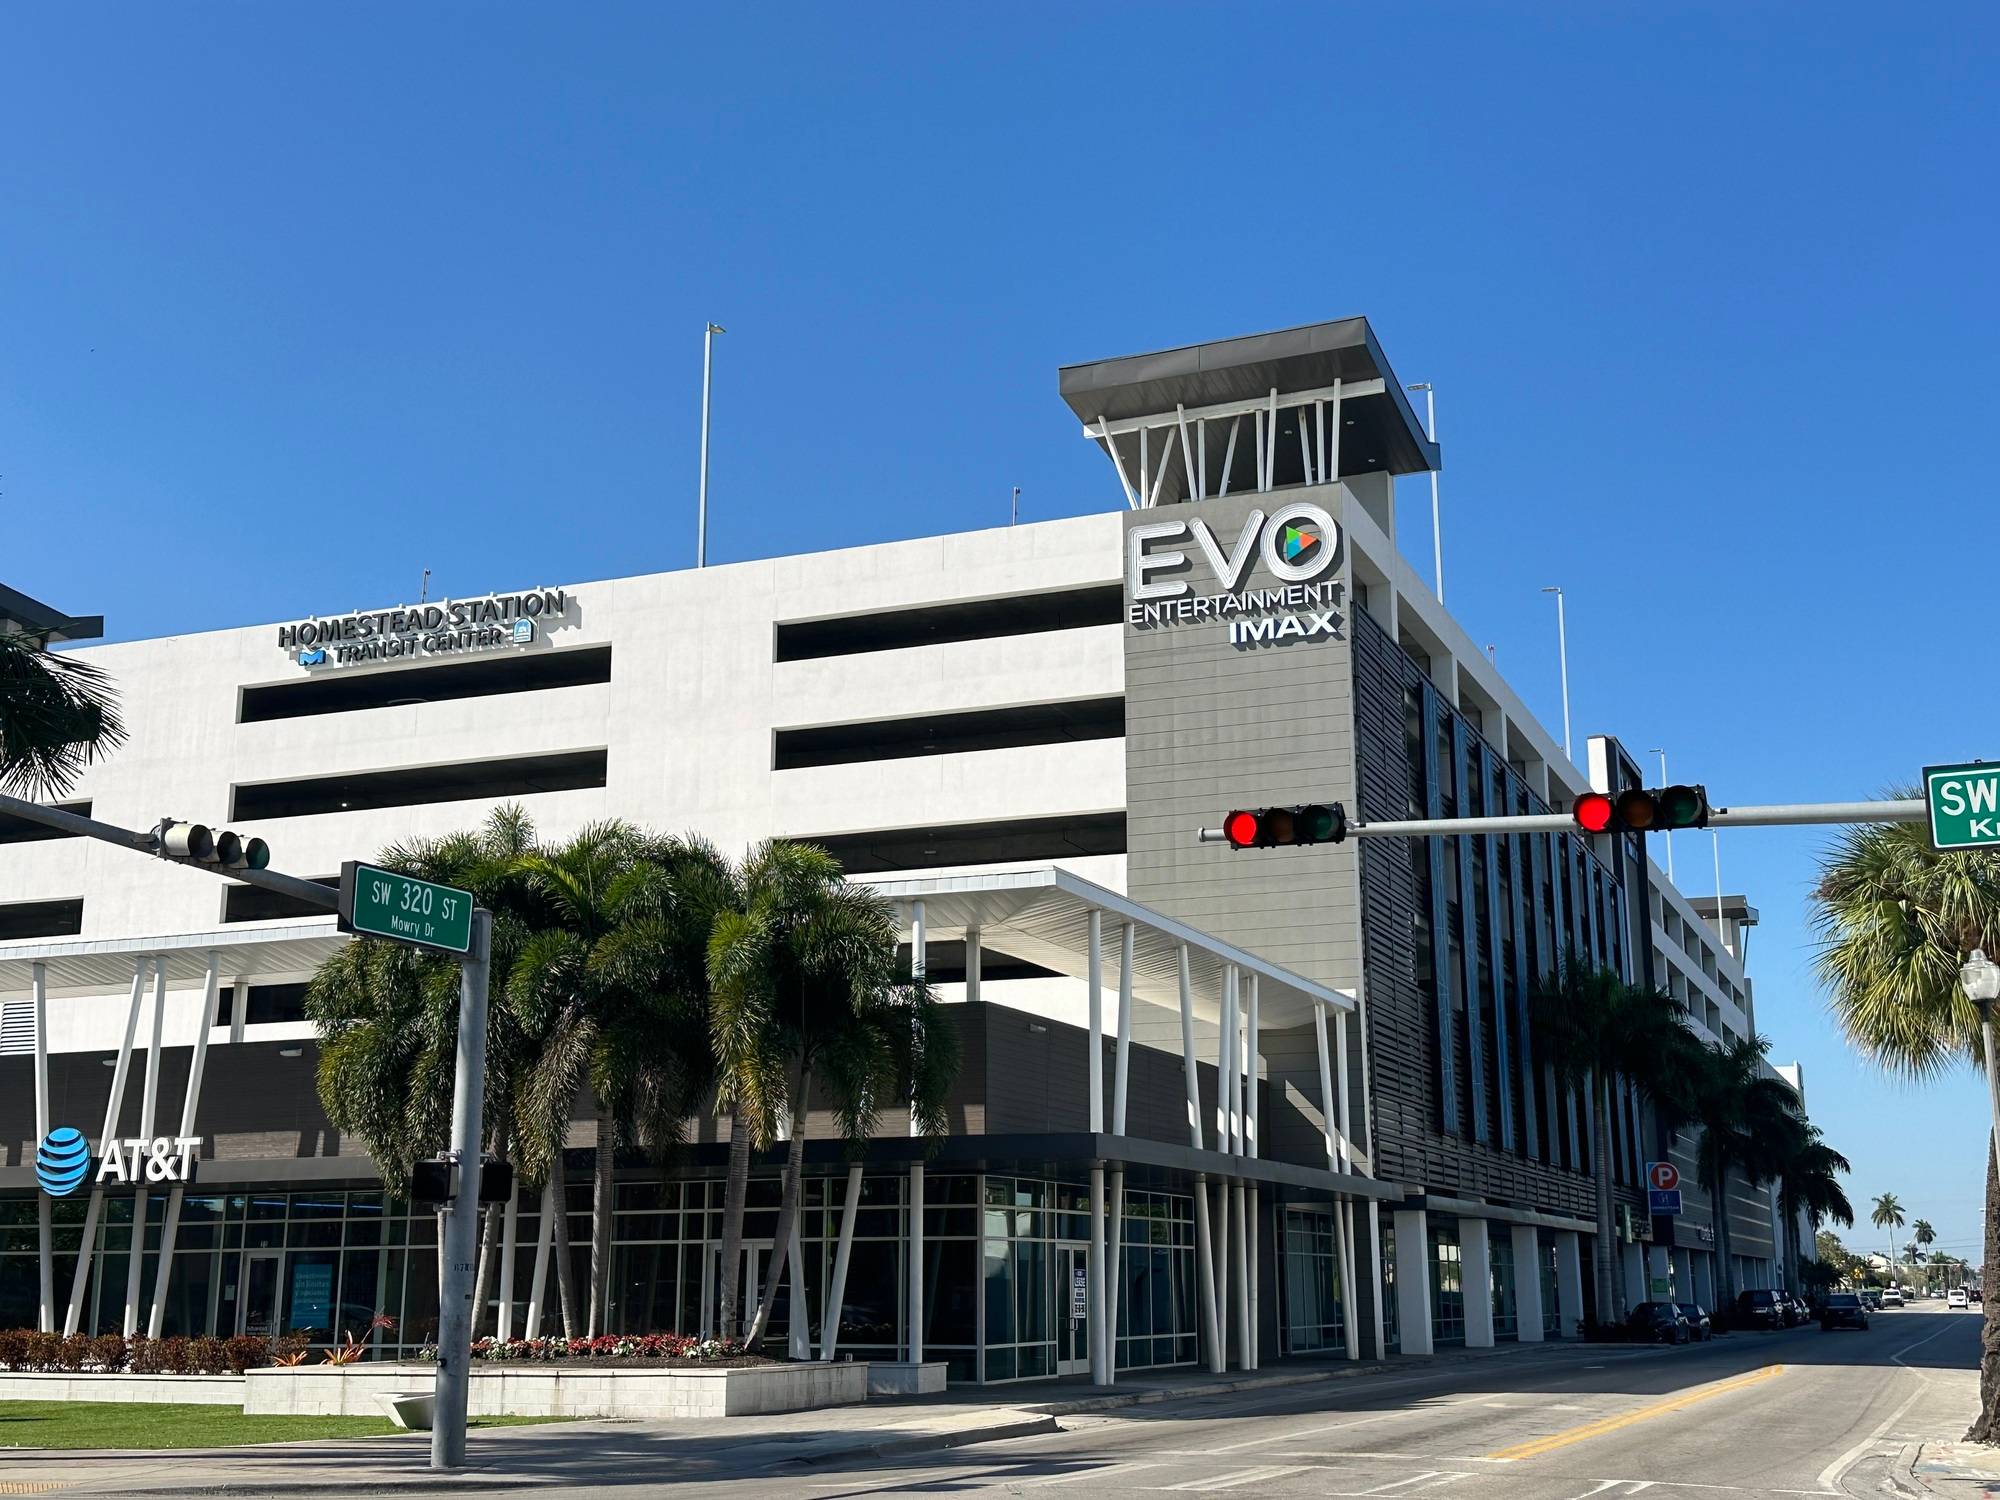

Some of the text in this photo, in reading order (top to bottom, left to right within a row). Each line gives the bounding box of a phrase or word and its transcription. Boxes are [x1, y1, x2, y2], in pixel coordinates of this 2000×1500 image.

[1128, 502, 1338, 600] EVO
[278, 590, 565, 648] HOMESTEAD STATION
[1128, 580, 1340, 624] ENTERTAINMENT
[334, 633, 419, 663] TRANSIT
[422, 627, 502, 652] CENTER
[1229, 610, 1340, 644] IMAX
[1940, 777, 1998, 816] SW
[371, 880, 458, 921] SW 320 ST
[391, 915, 436, 938] Mowry Dr
[95, 1137, 203, 1182] AT&T
[1657, 1167, 1673, 1187] P
